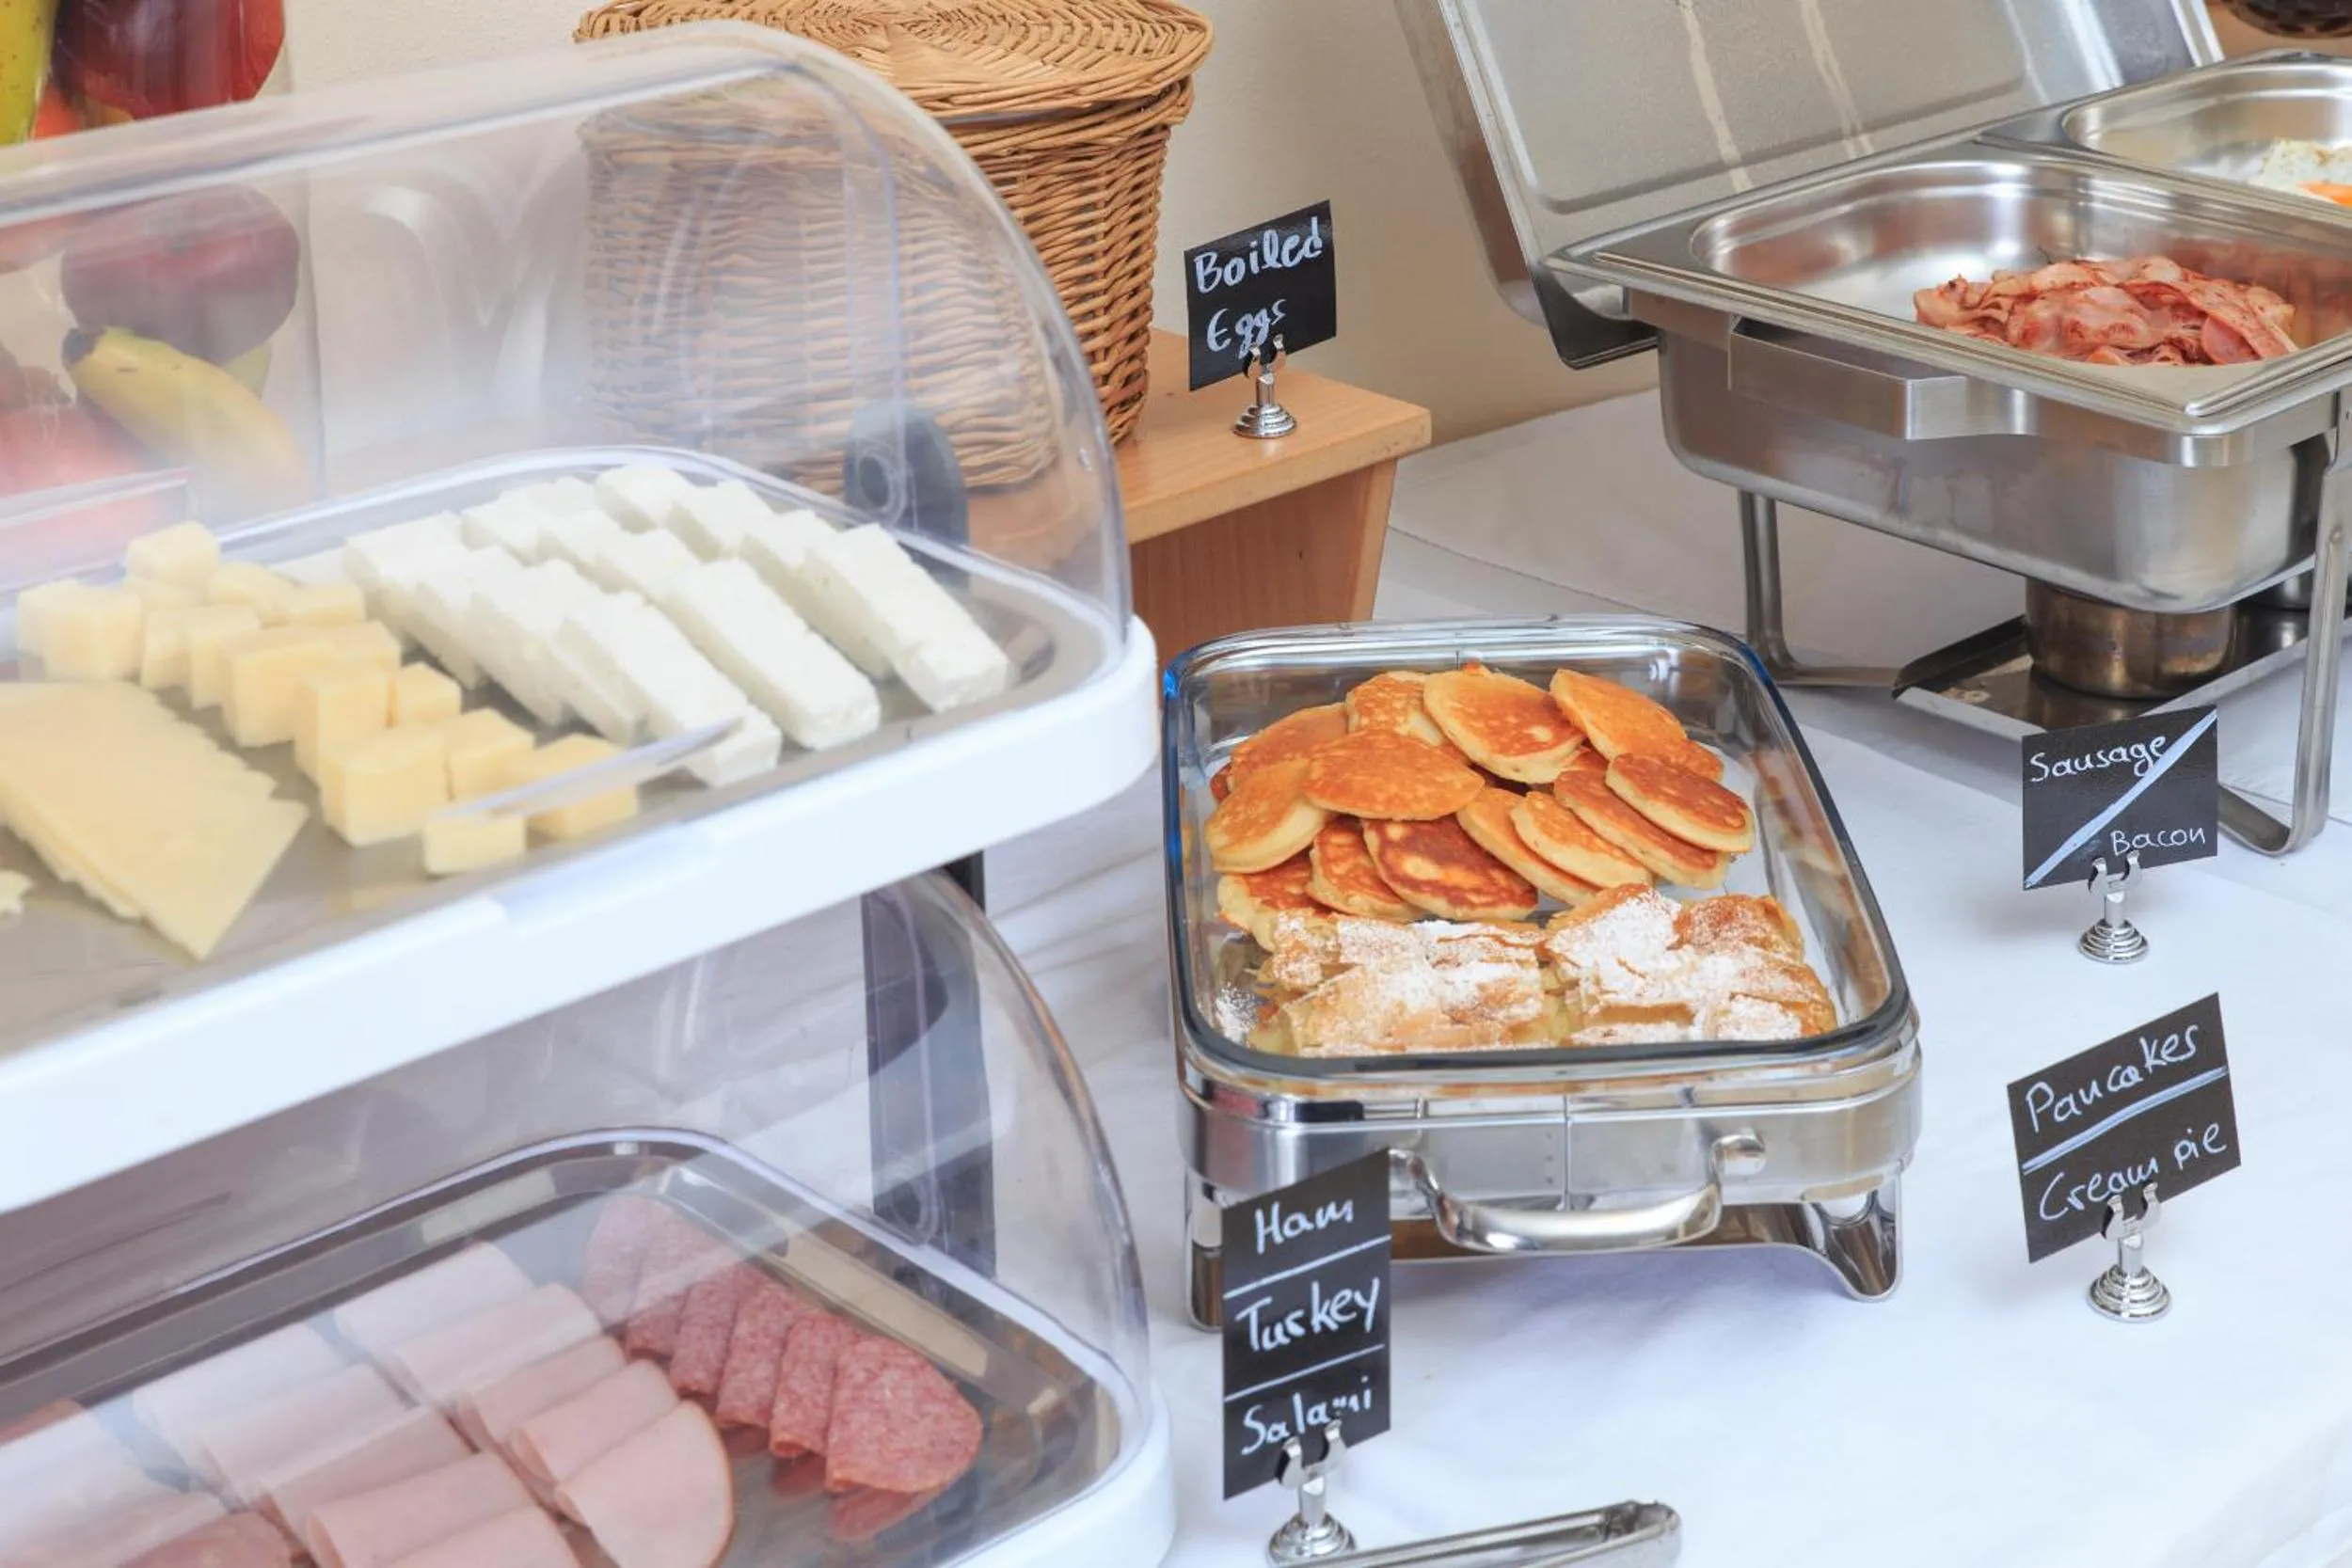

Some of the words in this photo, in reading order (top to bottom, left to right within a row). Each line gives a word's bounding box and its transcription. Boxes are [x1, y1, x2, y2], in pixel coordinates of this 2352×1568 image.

[1193, 215, 1324, 294] Boiled
[1206, 298, 1287, 360] Eggs
[2029, 736, 2167, 783] Sausage
[2110, 827, 2206, 856] Bacon
[2025, 1023, 2200, 1133] Pancakes
[2039, 1156, 2159, 1221] Cream
[2173, 1122, 2228, 1171] pie
[1254, 1198, 1355, 1256] Ham
[1234, 1275, 1381, 1353] Turkey
